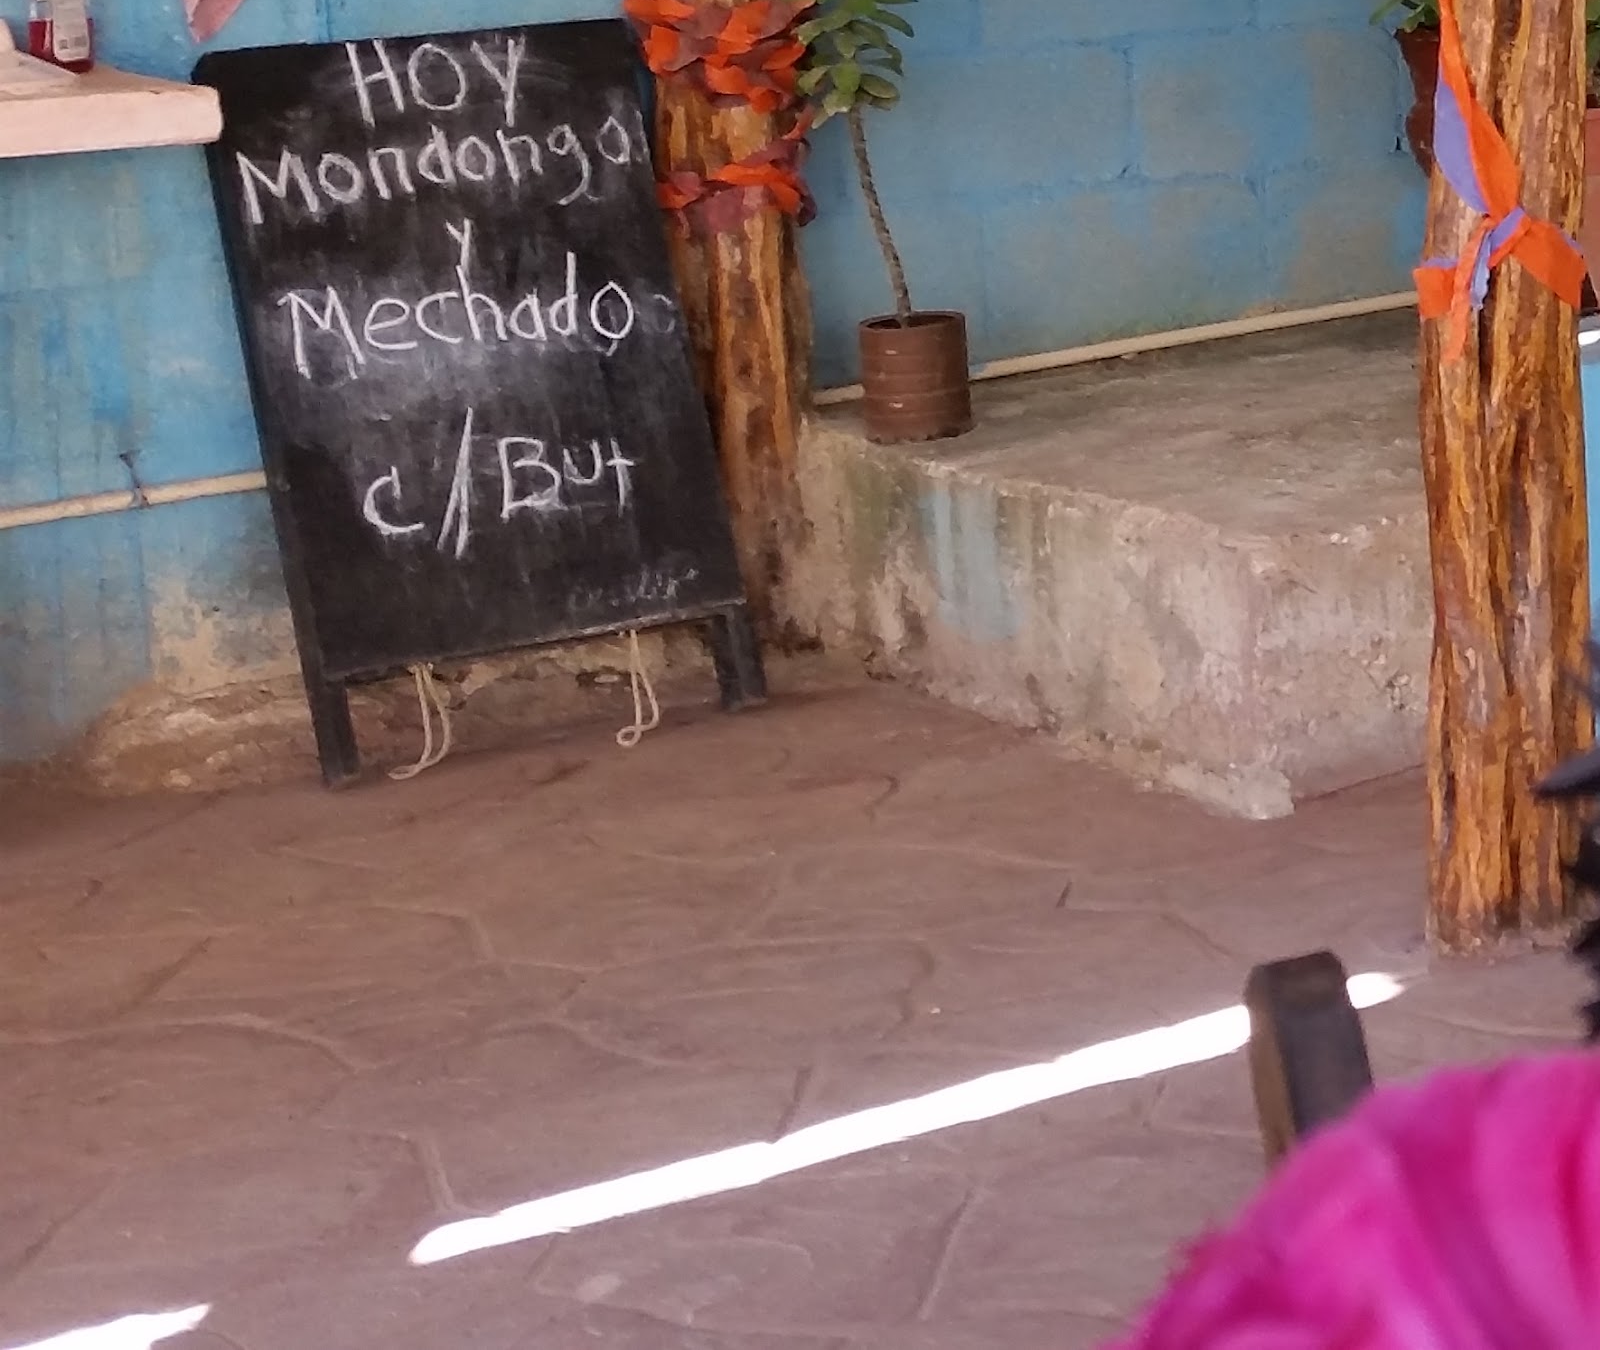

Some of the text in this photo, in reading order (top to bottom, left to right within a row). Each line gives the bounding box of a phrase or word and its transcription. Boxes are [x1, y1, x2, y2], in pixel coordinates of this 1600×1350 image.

[342, 33, 528, 129] HOY
[234, 114, 632, 227] Mondongo
[276, 250, 636, 380] Mechado
